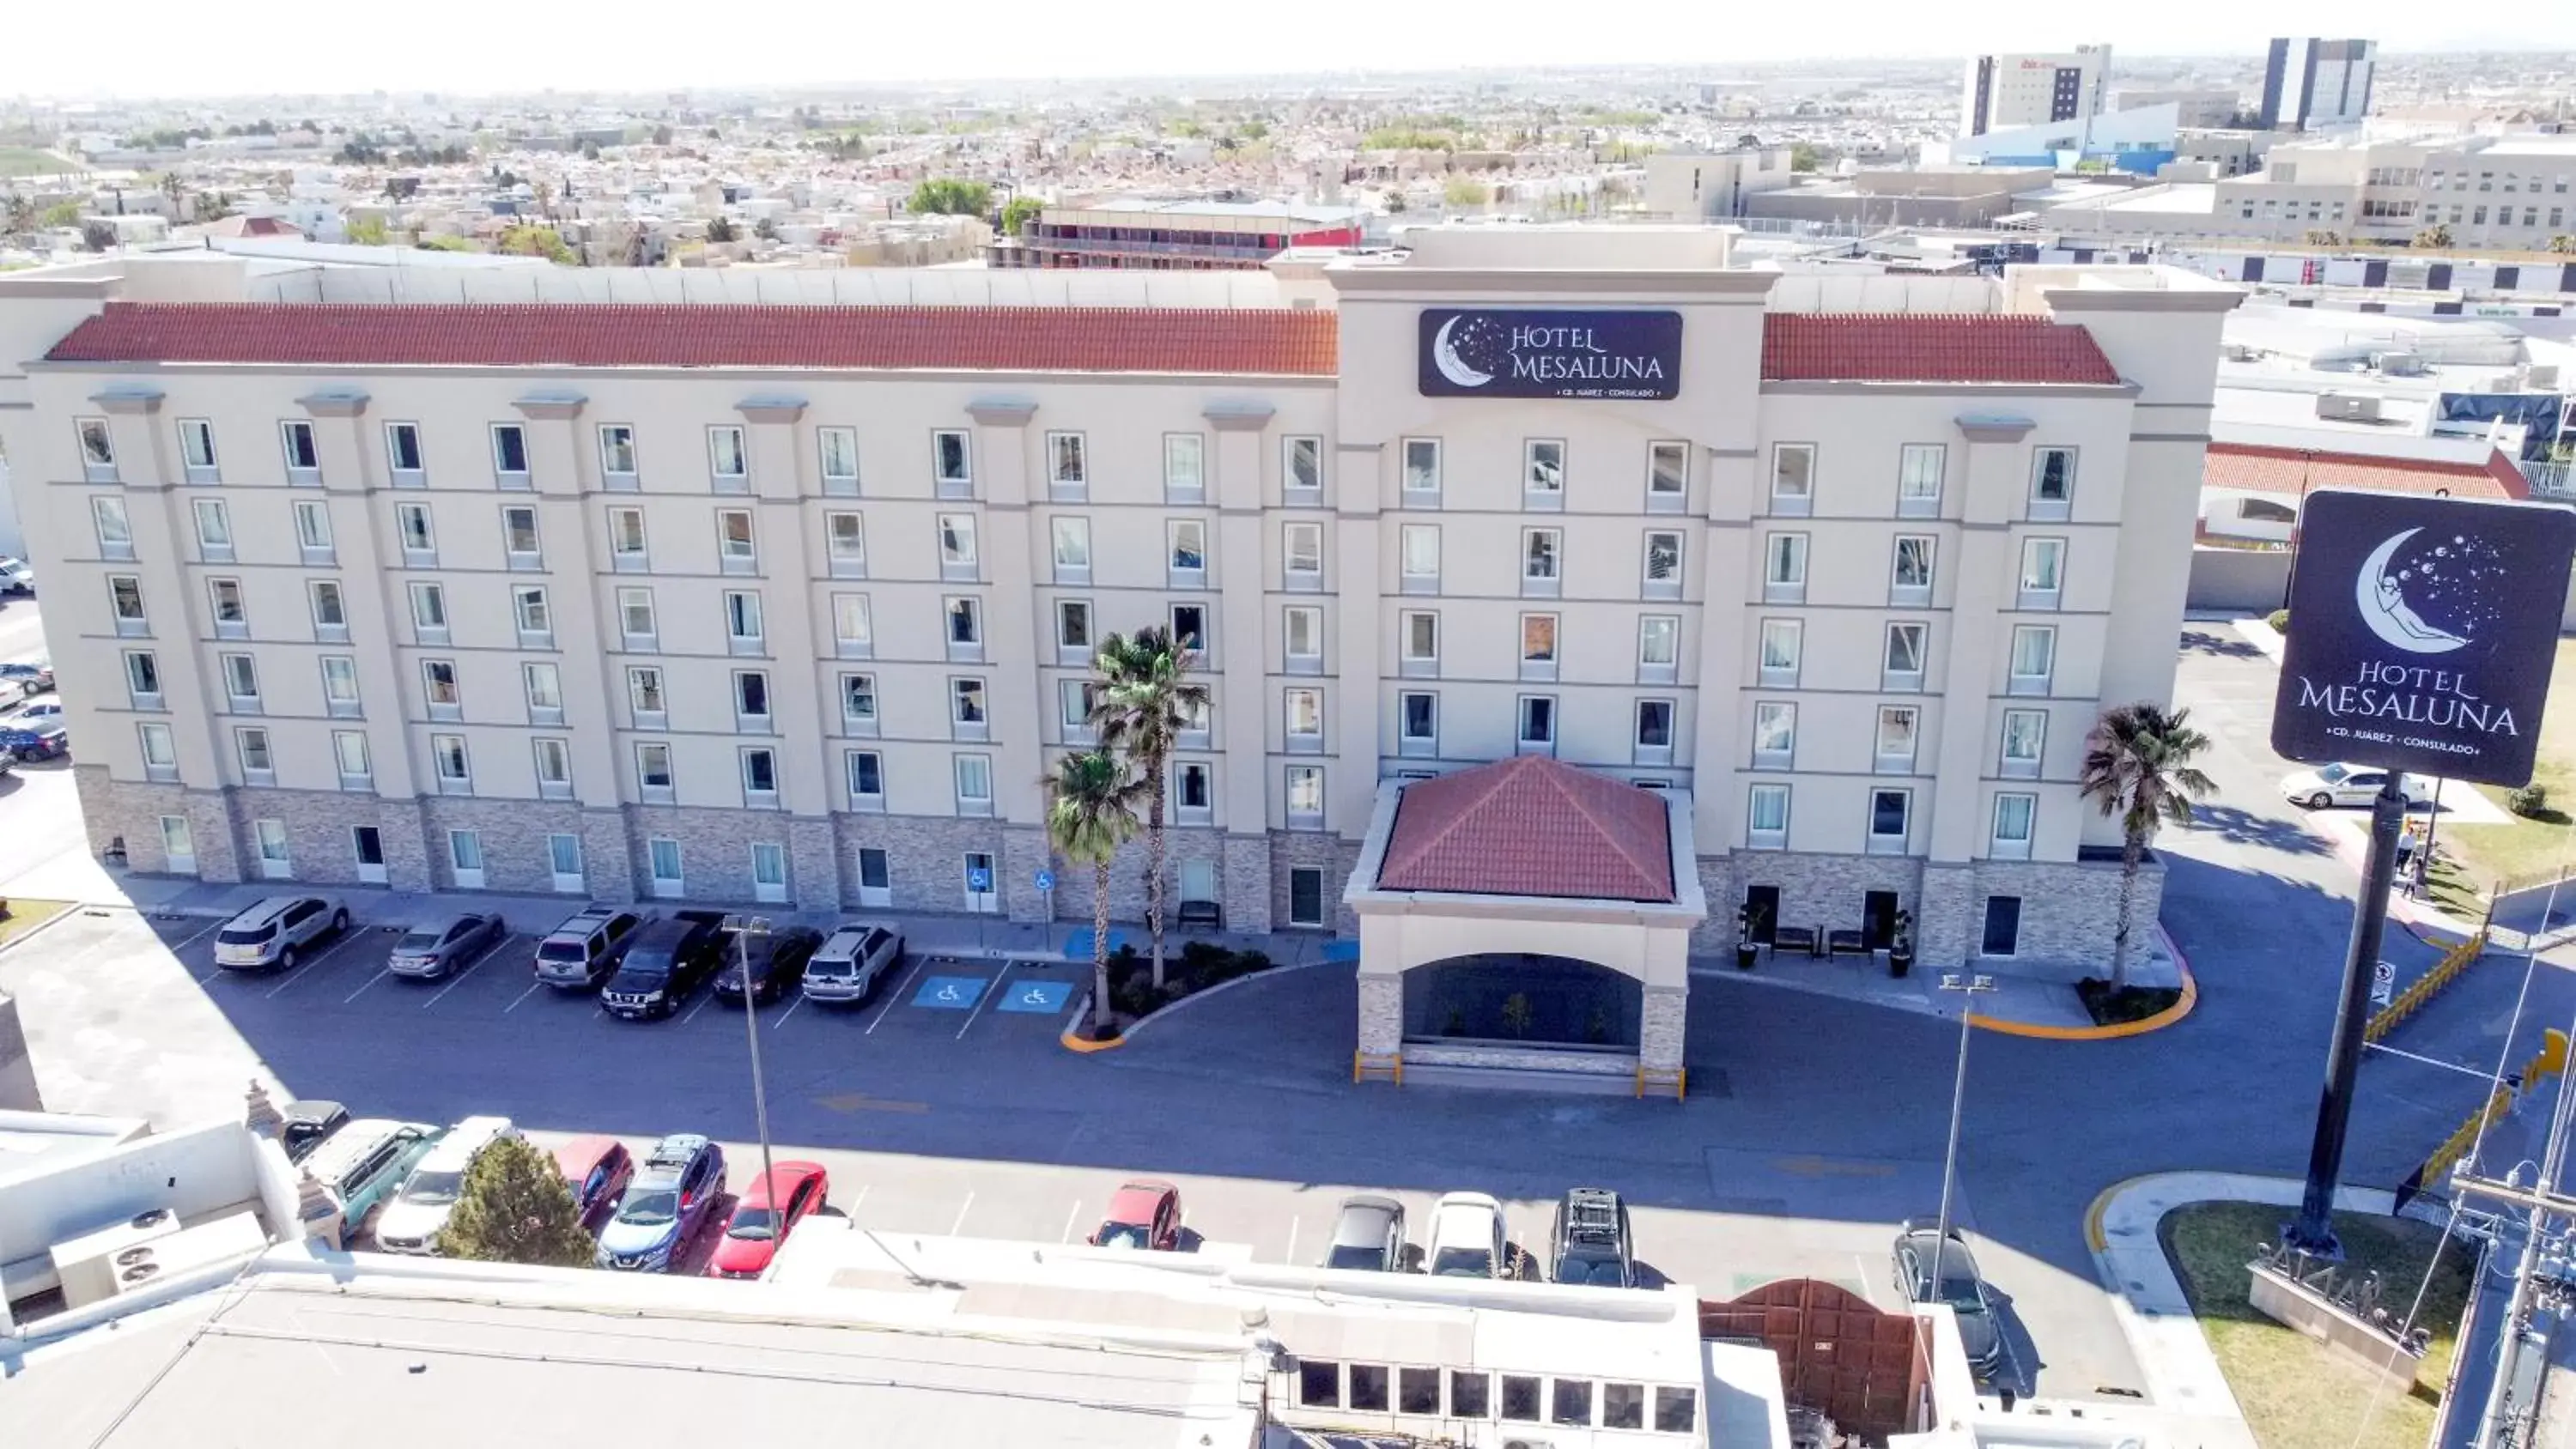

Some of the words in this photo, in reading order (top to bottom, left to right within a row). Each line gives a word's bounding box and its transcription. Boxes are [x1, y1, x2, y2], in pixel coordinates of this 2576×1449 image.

[1510, 326, 1607, 353] HOTEL
[1508, 349, 1663, 384] MESALUNA
[2358, 660, 2480, 700] HOTEL
[2298, 676, 2518, 737] MESALUNA
[2333, 727, 2350, 737] CD.
[2403, 736, 2474, 755] CONSULADO
